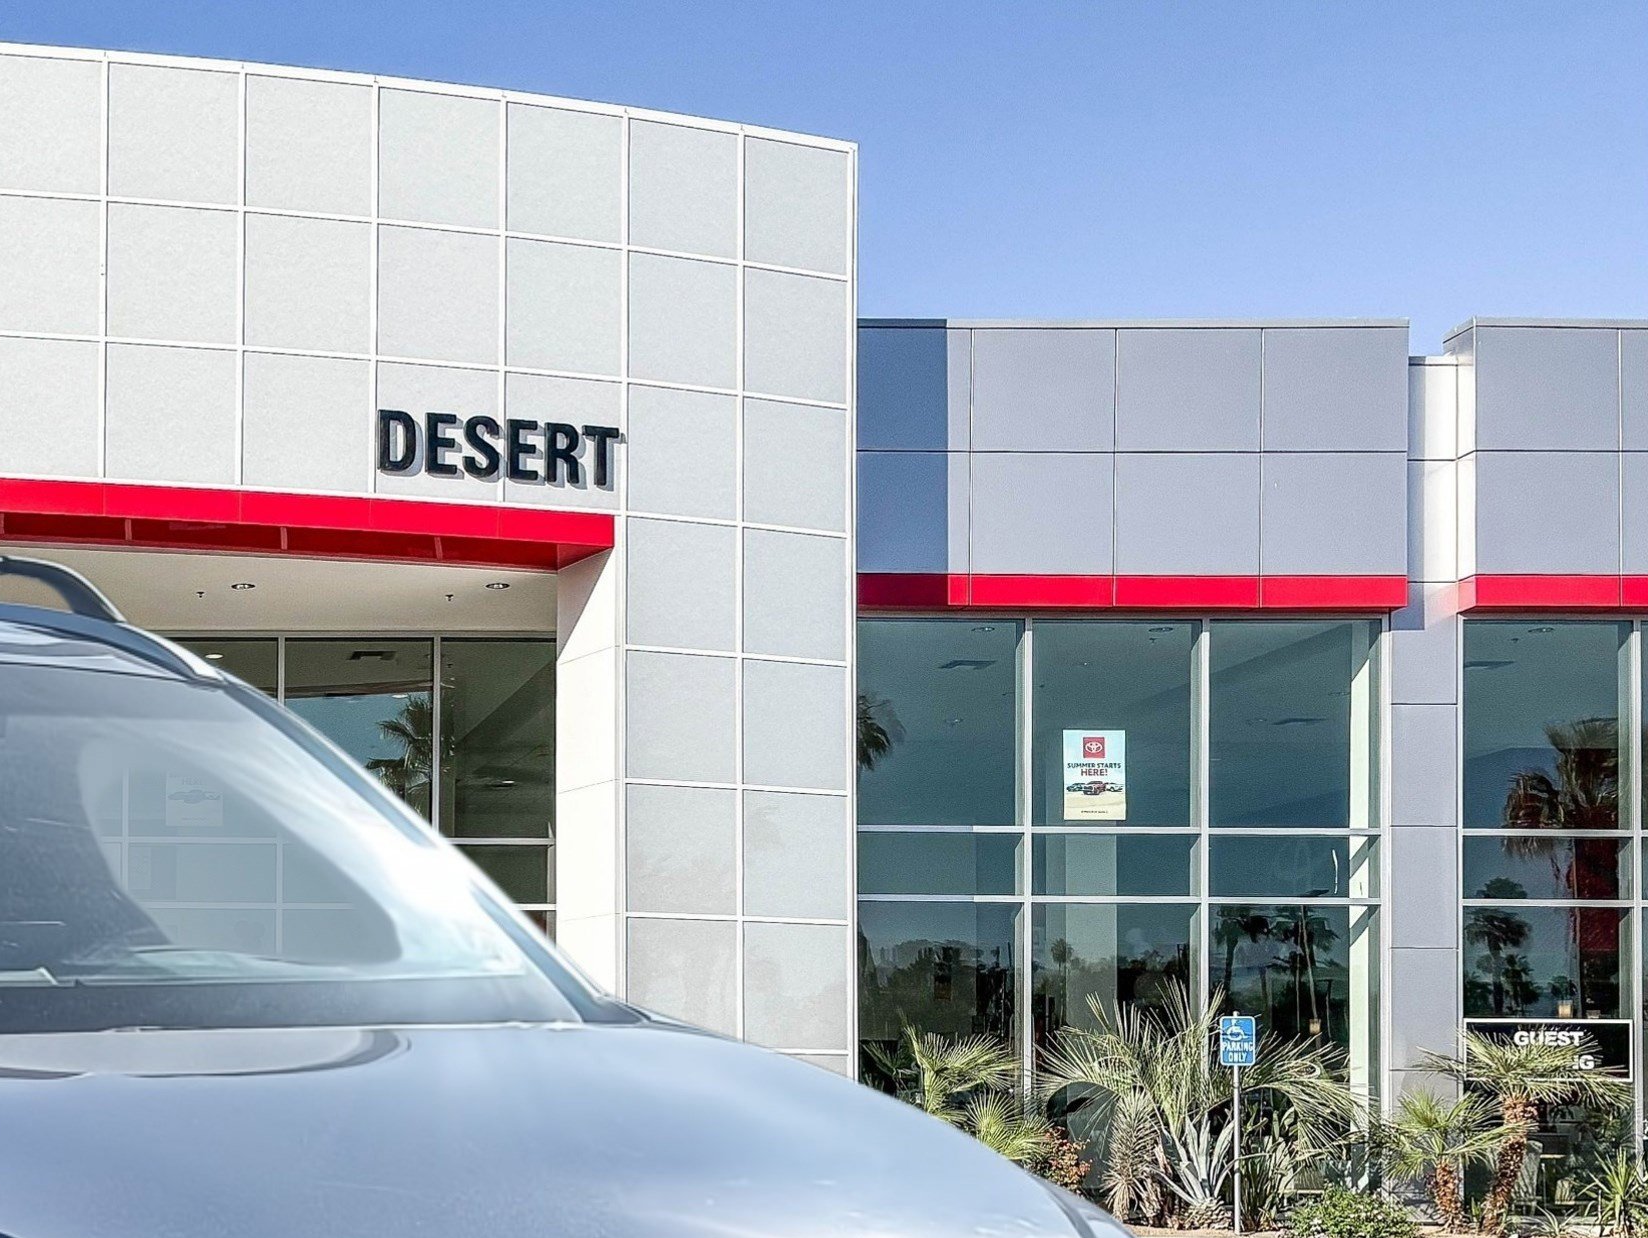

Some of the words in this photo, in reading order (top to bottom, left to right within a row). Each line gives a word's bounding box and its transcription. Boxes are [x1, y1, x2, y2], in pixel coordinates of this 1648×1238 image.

[376, 408, 621, 487] DESERT
[1080, 768, 1108, 777] HERE!
[1513, 1030, 1584, 1047] GUEST
[1222, 1041, 1254, 1052] PARKING
[1228, 1052, 1248, 1062] ONLY
